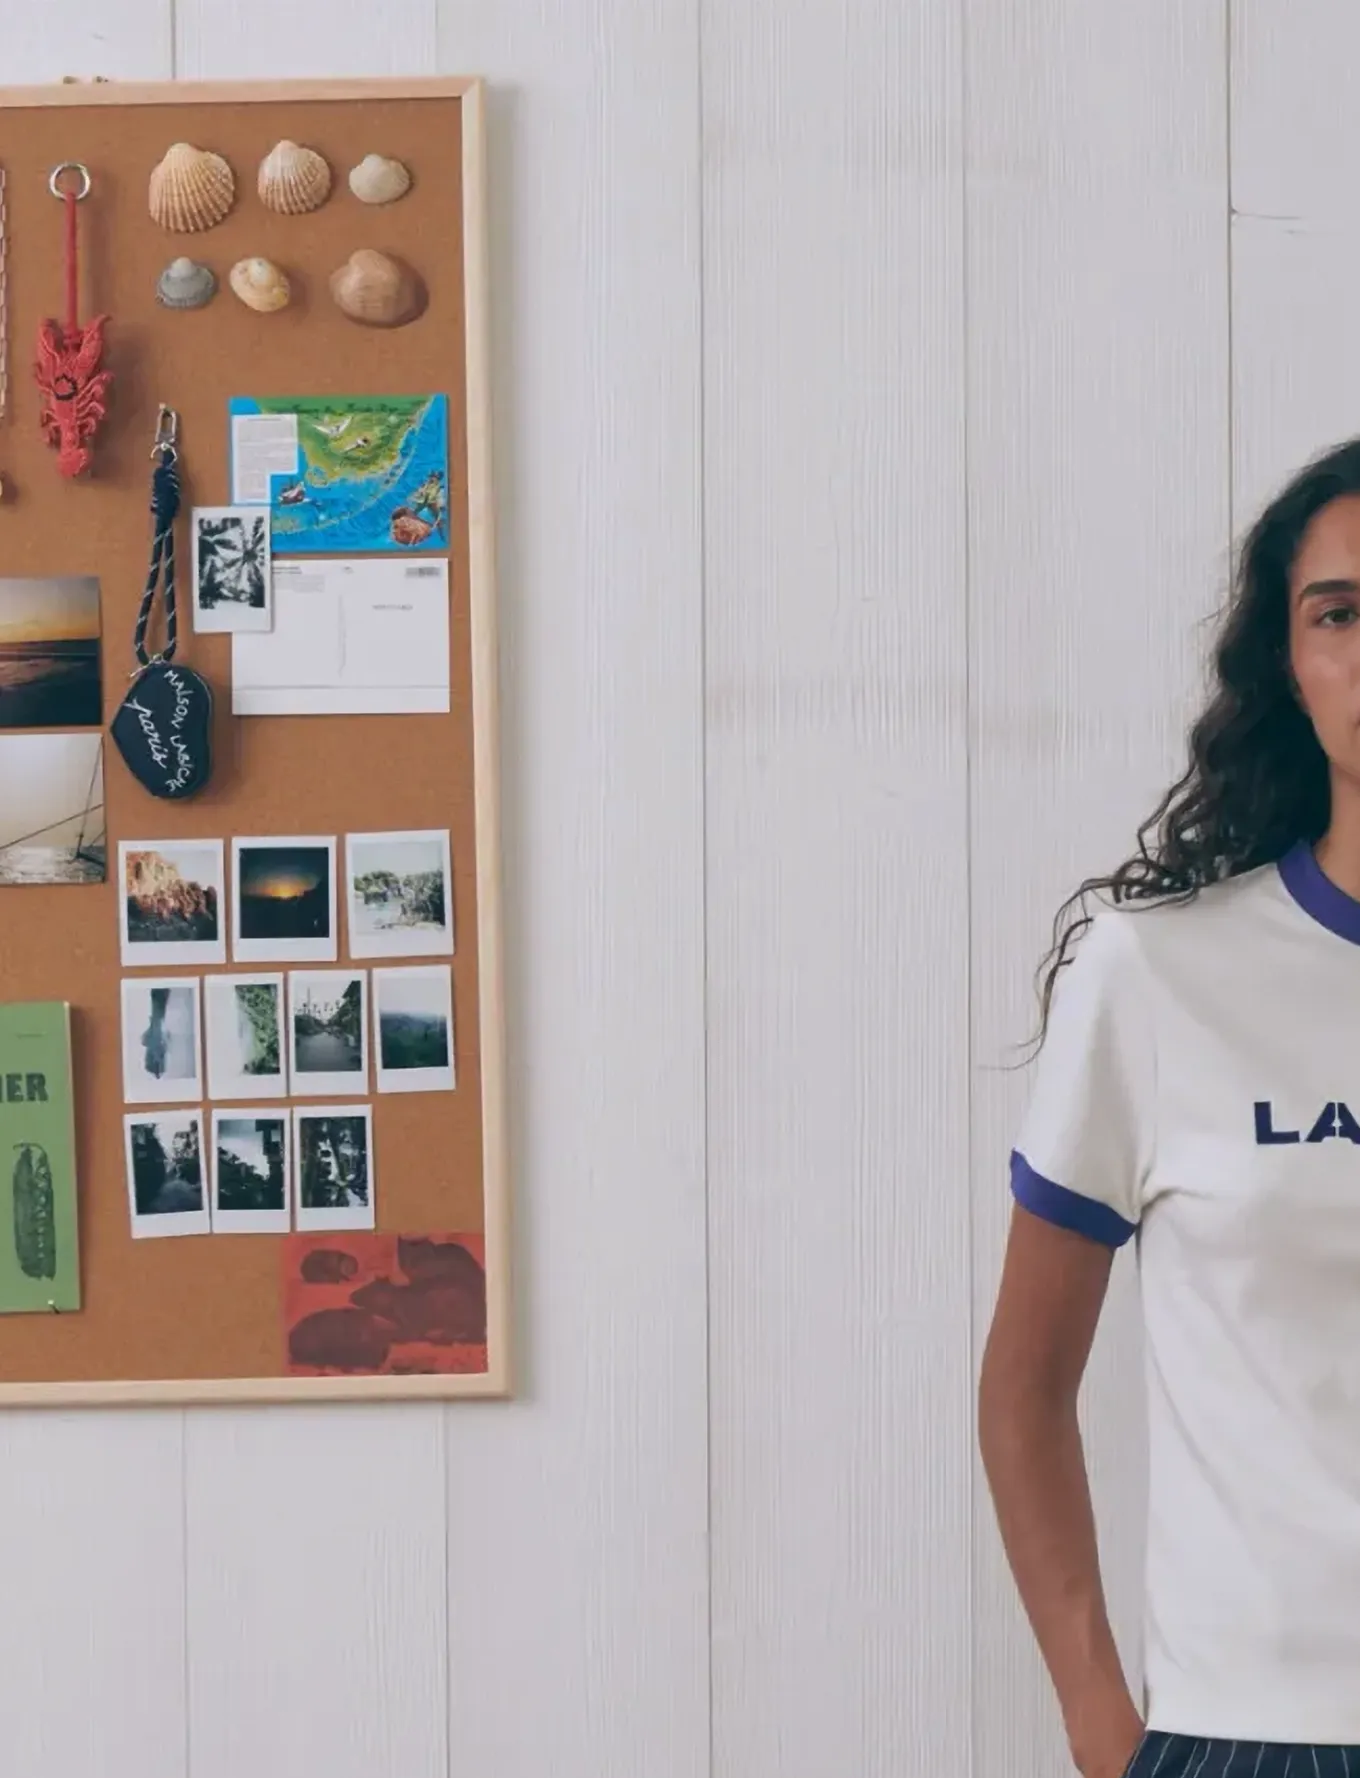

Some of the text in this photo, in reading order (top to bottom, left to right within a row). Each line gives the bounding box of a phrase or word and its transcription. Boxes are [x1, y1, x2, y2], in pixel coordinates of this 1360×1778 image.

[121, 695, 168, 769] paris
[163, 669, 195, 792] MAISON LABICHE
[0, 1072, 49, 1103] ER
